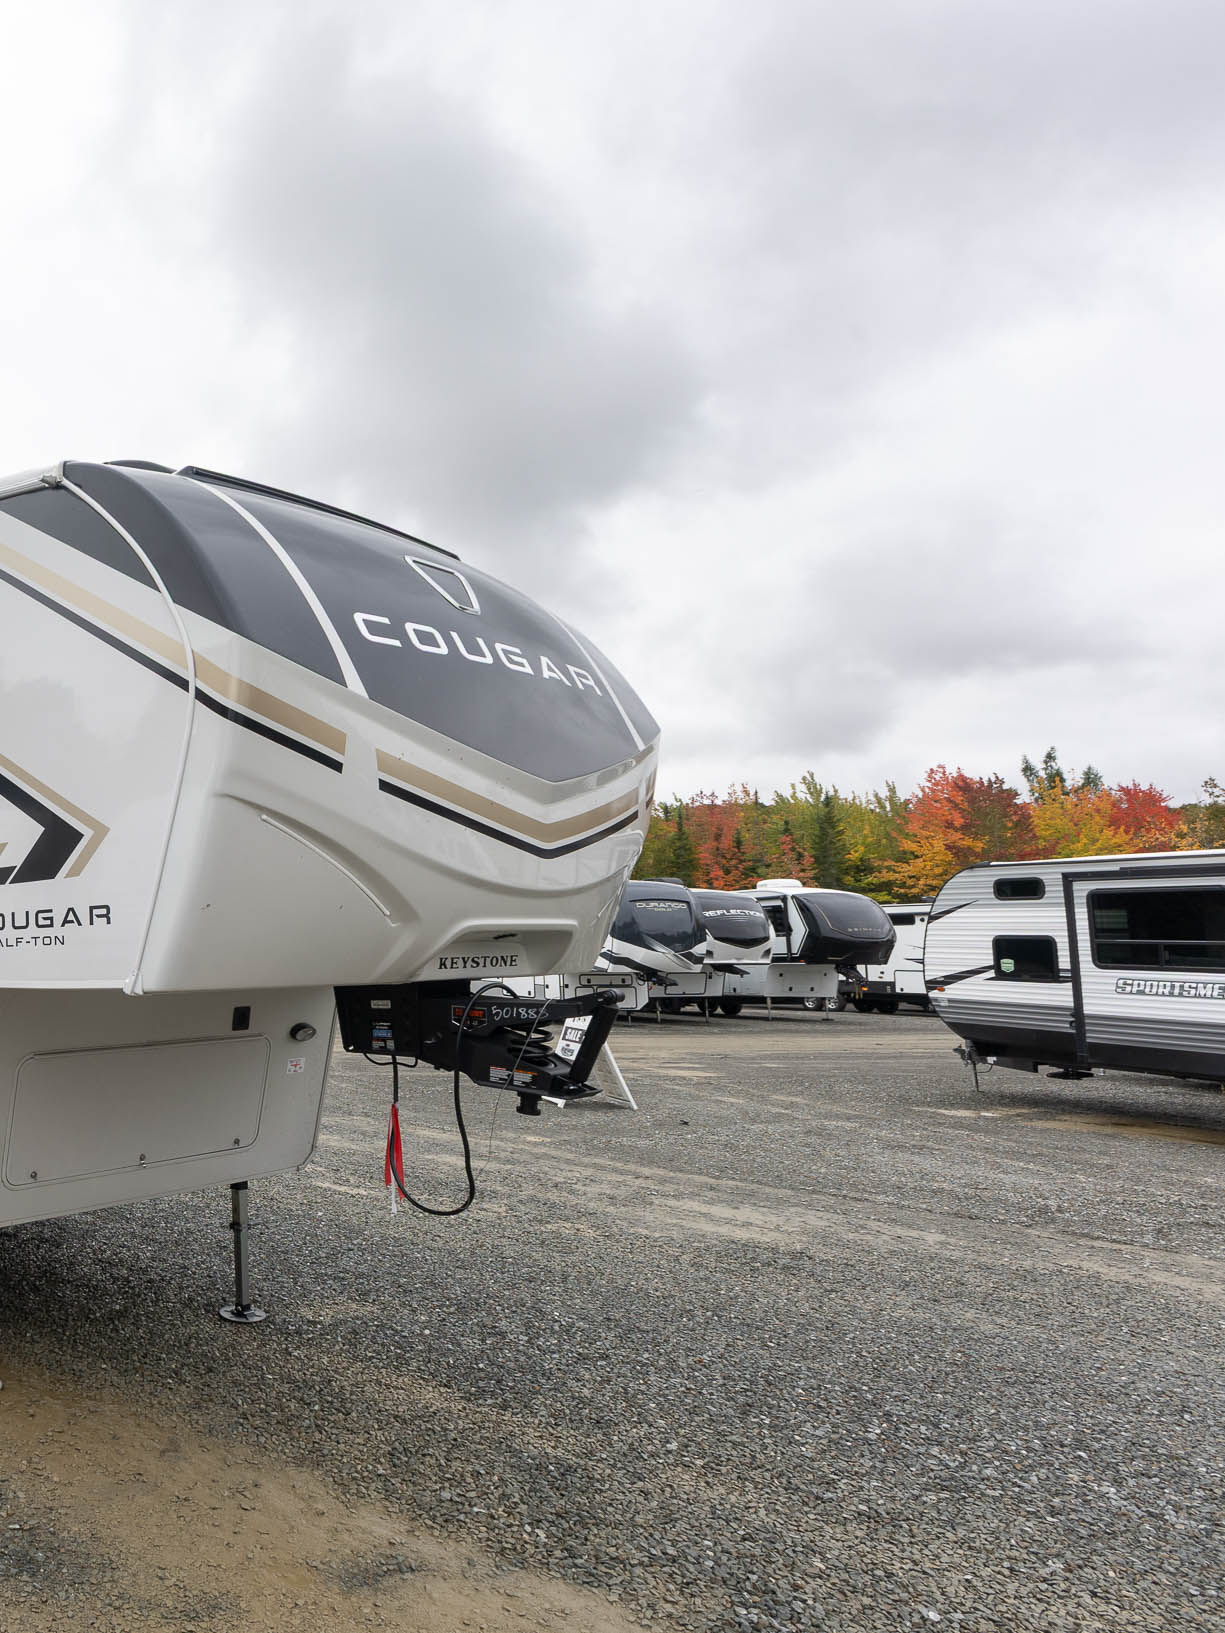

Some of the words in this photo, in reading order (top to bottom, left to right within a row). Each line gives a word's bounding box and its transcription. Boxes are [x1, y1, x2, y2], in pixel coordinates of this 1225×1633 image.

[353, 612, 602, 697] COUGAR
[437, 954, 519, 970] KEYSTONE
[1115, 978, 1225, 999] SPORTSME
[565, 1028, 583, 1042] SALE
